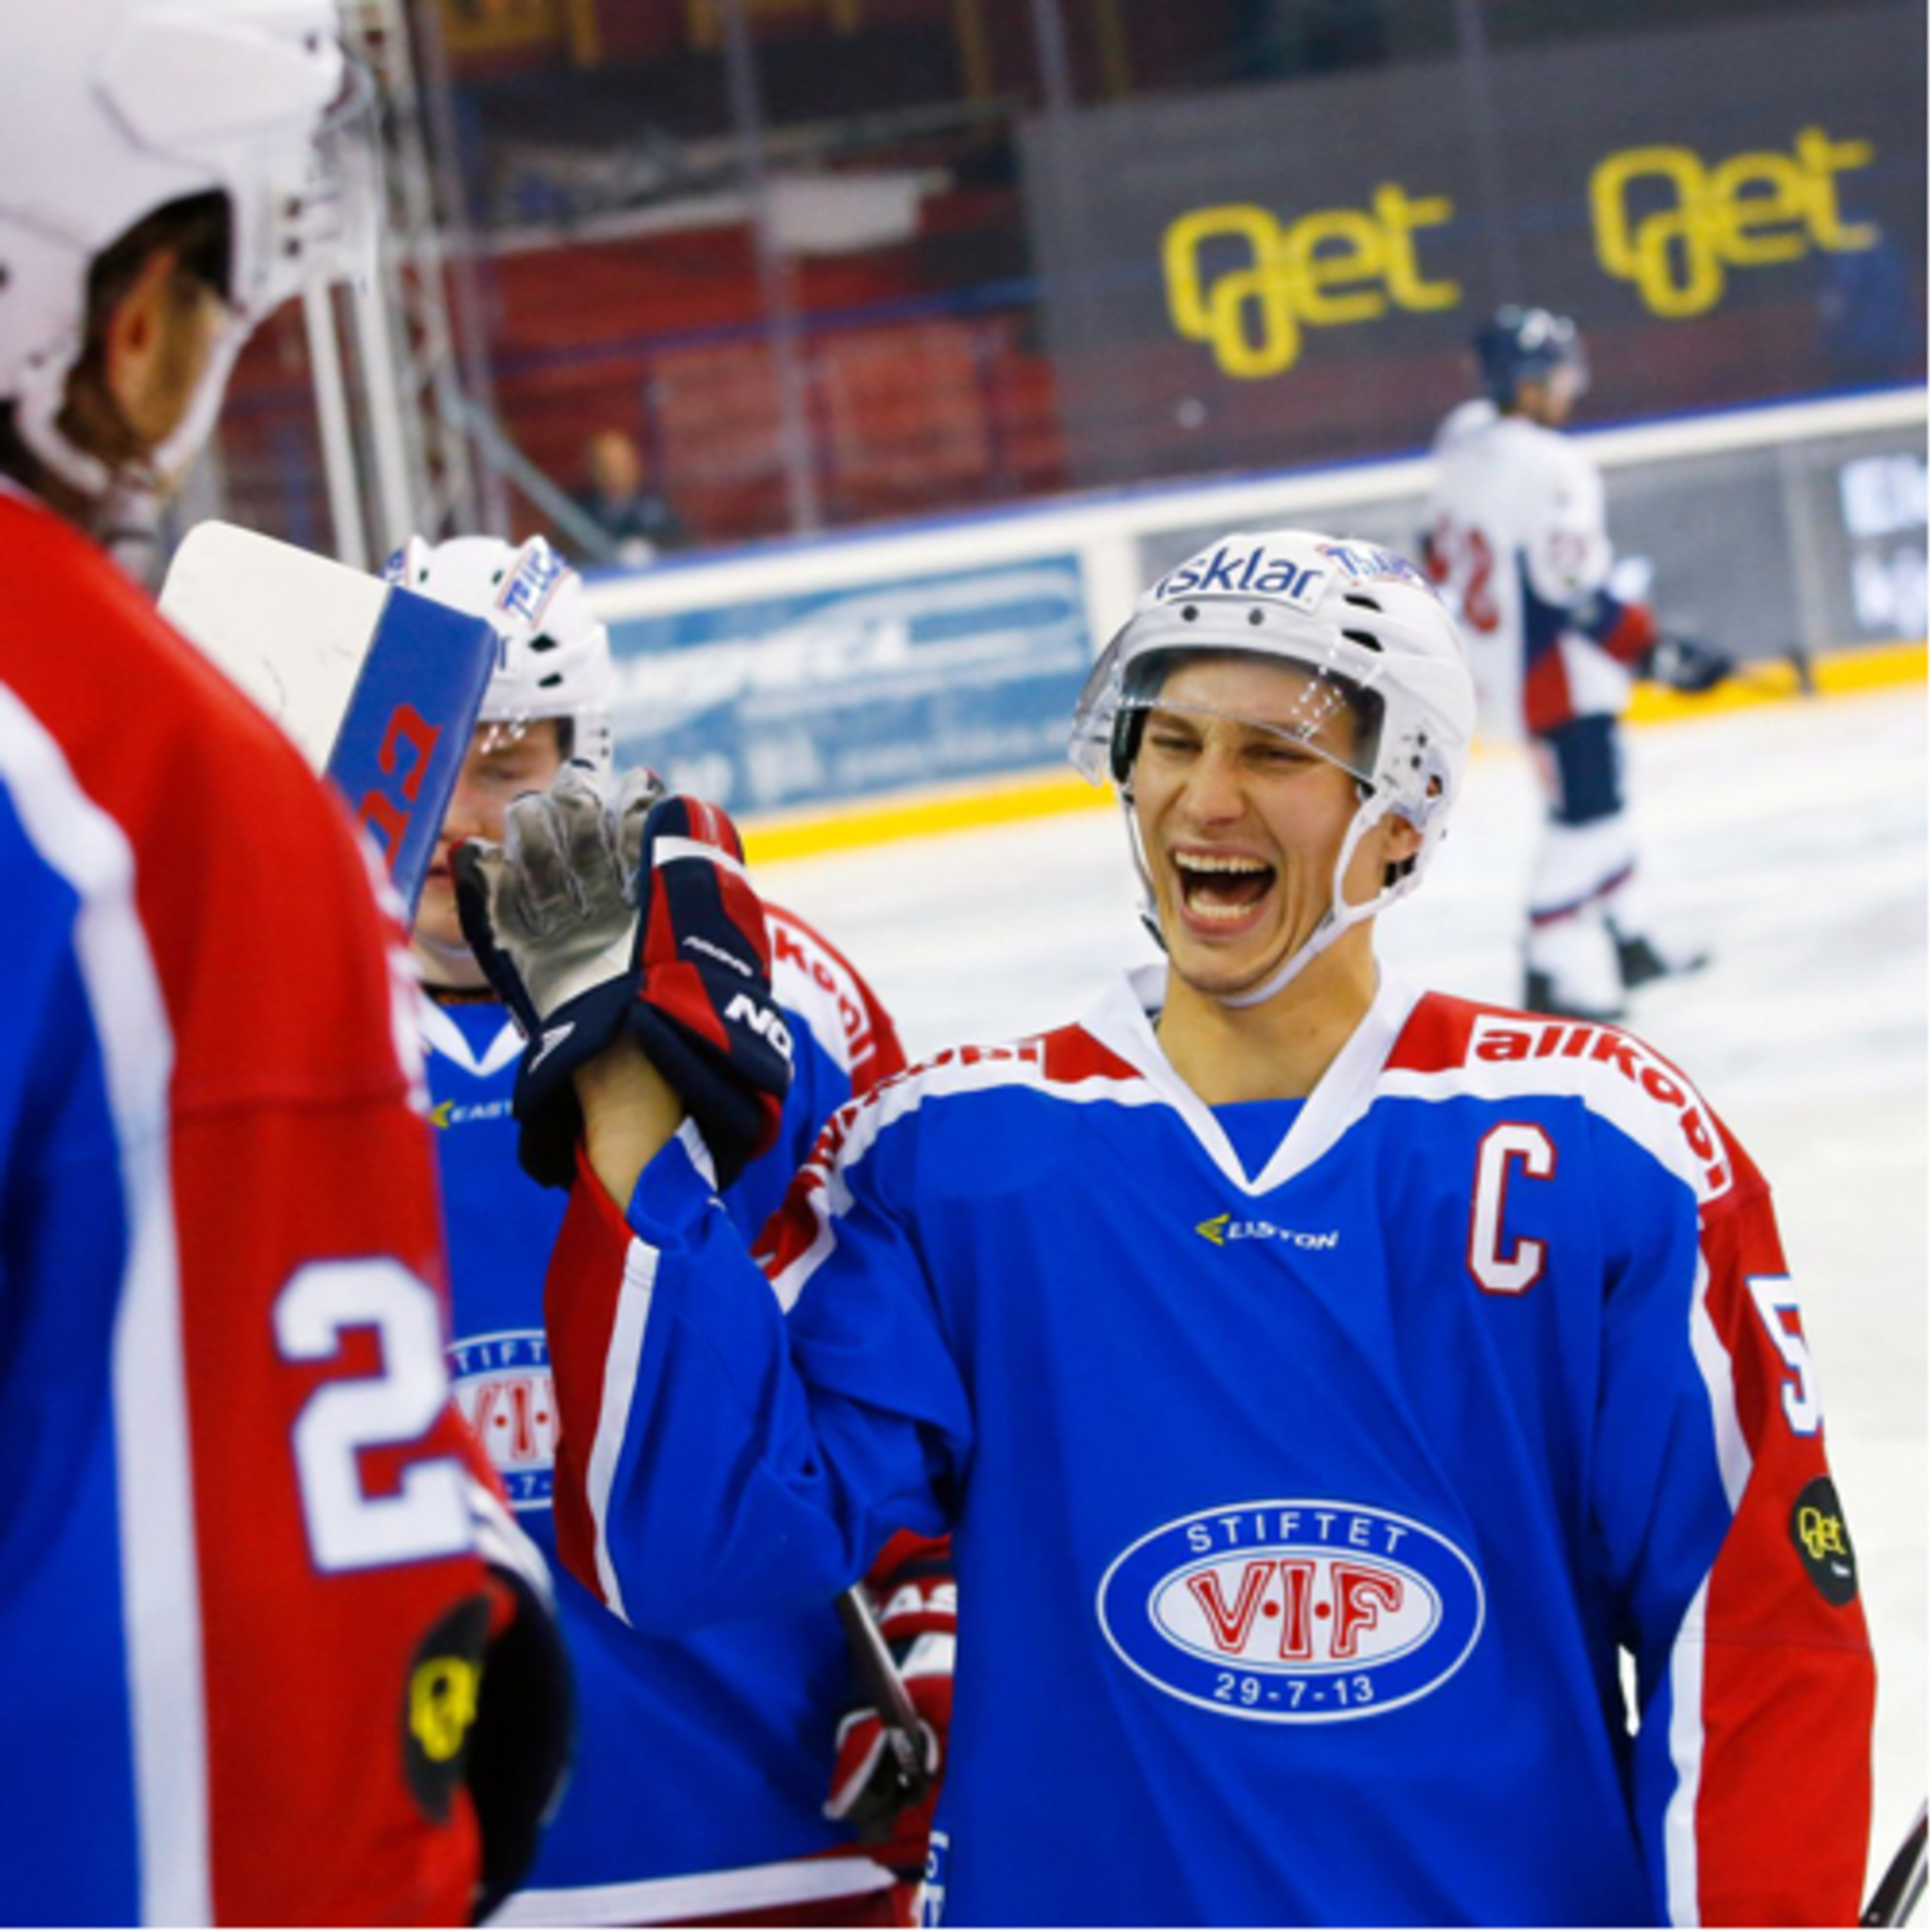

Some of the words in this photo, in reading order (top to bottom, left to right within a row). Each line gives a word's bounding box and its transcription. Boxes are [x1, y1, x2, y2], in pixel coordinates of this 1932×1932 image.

[1466, 1119, 1558, 1297] C
[271, 1255, 477, 1575] 2
[1187, 1512, 1408, 1554] STIFTET
[1213, 1673, 1374, 1707] 29-7-13
